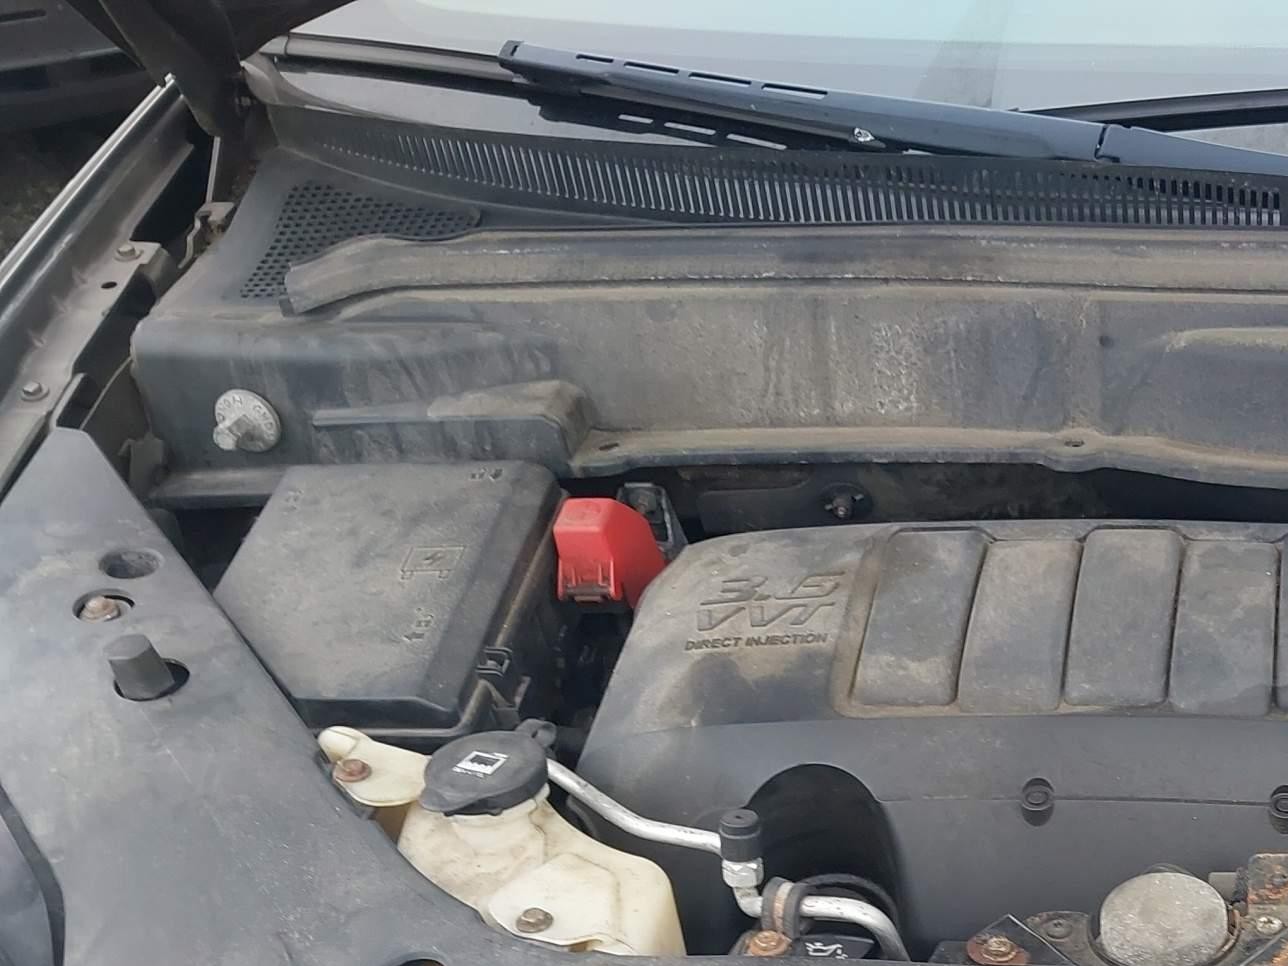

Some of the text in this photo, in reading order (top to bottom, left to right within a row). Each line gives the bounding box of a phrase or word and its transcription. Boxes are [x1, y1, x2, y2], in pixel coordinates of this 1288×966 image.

[700, 571, 846, 606] 3.6
[697, 602, 836, 632] VVT
[684, 633, 828, 651] DIRECT INJECTION
